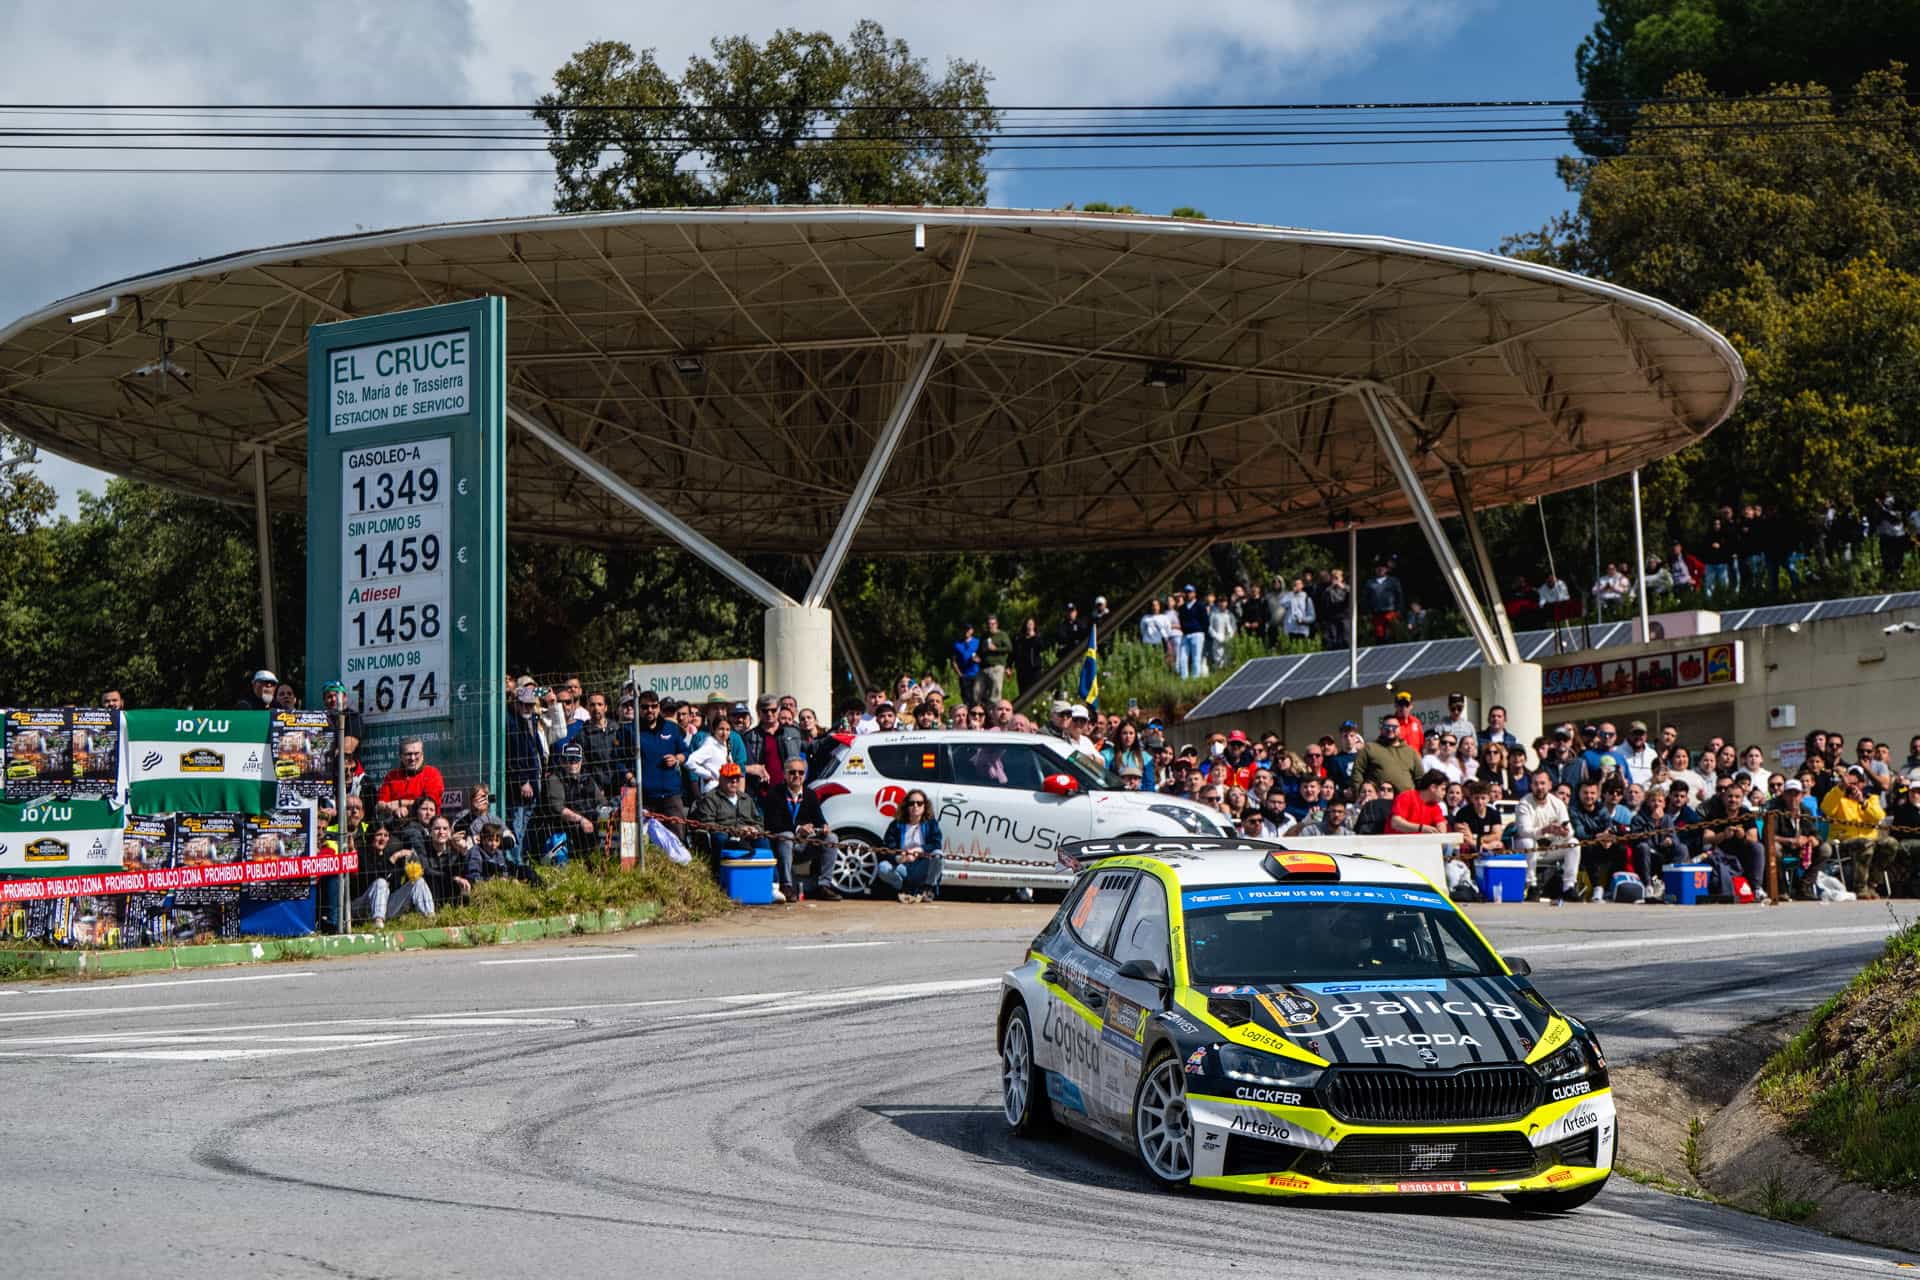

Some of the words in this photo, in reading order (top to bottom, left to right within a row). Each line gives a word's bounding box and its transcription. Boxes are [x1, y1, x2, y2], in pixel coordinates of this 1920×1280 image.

[334, 356, 365, 384] EL
[376, 338, 466, 378] CRUCE
[337, 390, 358, 406] Sta.
[395, 382, 409, 397] de
[413, 374, 463, 394] Trassierra
[335, 407, 388, 426] ESTACION
[393, 404, 407, 417] DE
[412, 395, 465, 415] SERVICIO
[349, 446, 421, 469] GASOLEO-A
[352, 468, 439, 511] 1.349
[348, 519, 366, 537] SIN
[367, 516, 405, 535] PLOMO
[407, 514, 421, 530] 95
[354, 534, 440, 578] 1.459
[348, 585, 401, 605] Adiesel
[352, 603, 441, 647] 1.458
[347, 655, 365, 673] SIN
[367, 652, 405, 670] PLOMO
[407, 650, 421, 666] 98
[351, 671, 437, 713] 1.674
[650, 677, 669, 692] SIN
[671, 675, 711, 691] PLOMO
[713, 673, 729, 689] 98
[175, 718, 229, 735] JOYLU
[20, 805, 72, 824] JOYLU
[4, 884, 44, 899] PROHIBIDO
[47, 880, 79, 896] PUBLICO
[82, 877, 103, 895] ZONA
[105, 874, 145, 893] PROHIBIDO
[148, 870, 179, 889] PUBLICO
[182, 869, 202, 885] ZONA
[204, 865, 243, 882] PROHIBIDO
[246, 861, 277, 879] PUBLICO
[279, 860, 300, 875] ZONA
[302, 856, 340, 873] PROHIBIDO
[1327, 996, 1522, 1024] galicia
[1043, 1000, 1100, 1073] Logista
[1241, 1027, 1285, 1050] Logista
[1236, 1086, 1302, 1105] CLICKFER
[1552, 1081, 1591, 1101] CLICKFER
[1230, 1115, 1290, 1139] Arteixo
[1562, 1111, 1598, 1134] Arteixo
